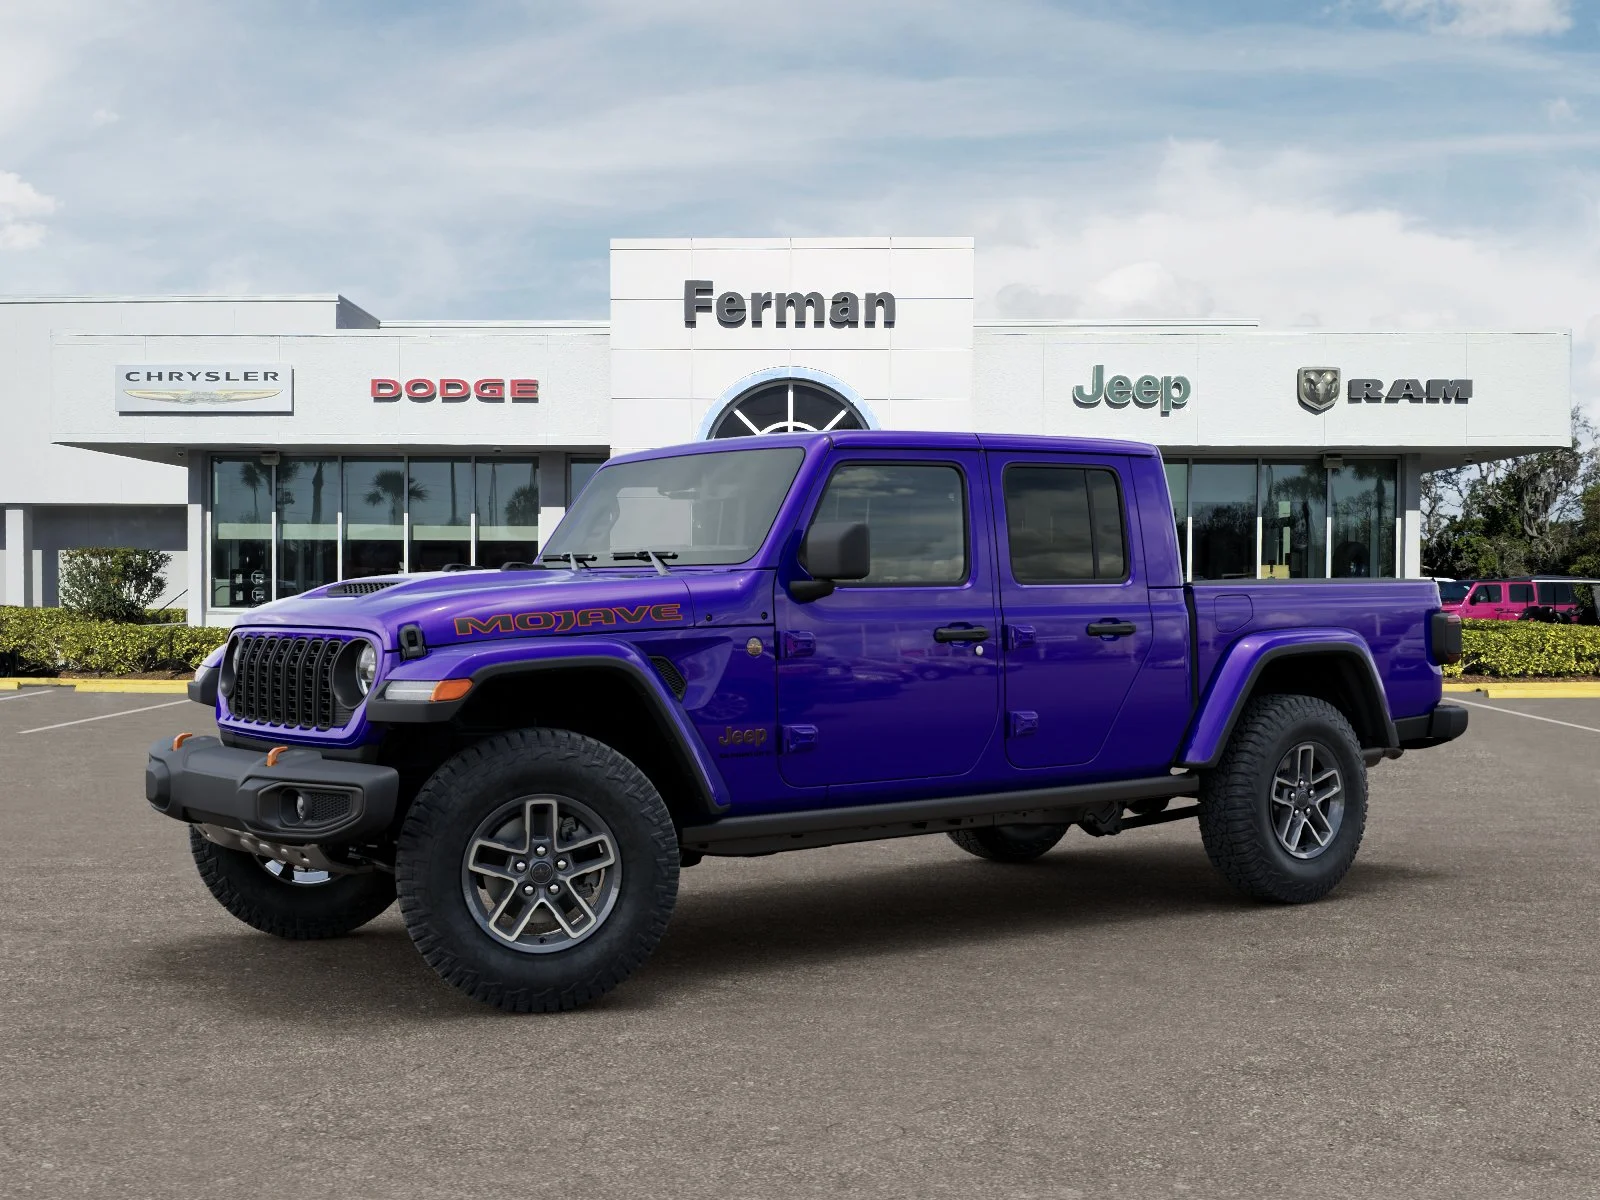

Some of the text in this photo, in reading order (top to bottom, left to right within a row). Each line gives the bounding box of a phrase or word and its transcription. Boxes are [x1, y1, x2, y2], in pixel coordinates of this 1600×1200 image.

[684, 280, 896, 328] Ferman
[125, 371, 280, 382] CHRYSLER
[370, 378, 539, 403] DODGE
[1072, 365, 1191, 416] Jeep
[1348, 379, 1473, 404] RAM
[453, 603, 683, 635] MOJAVE
[718, 726, 767, 746] Jeep
